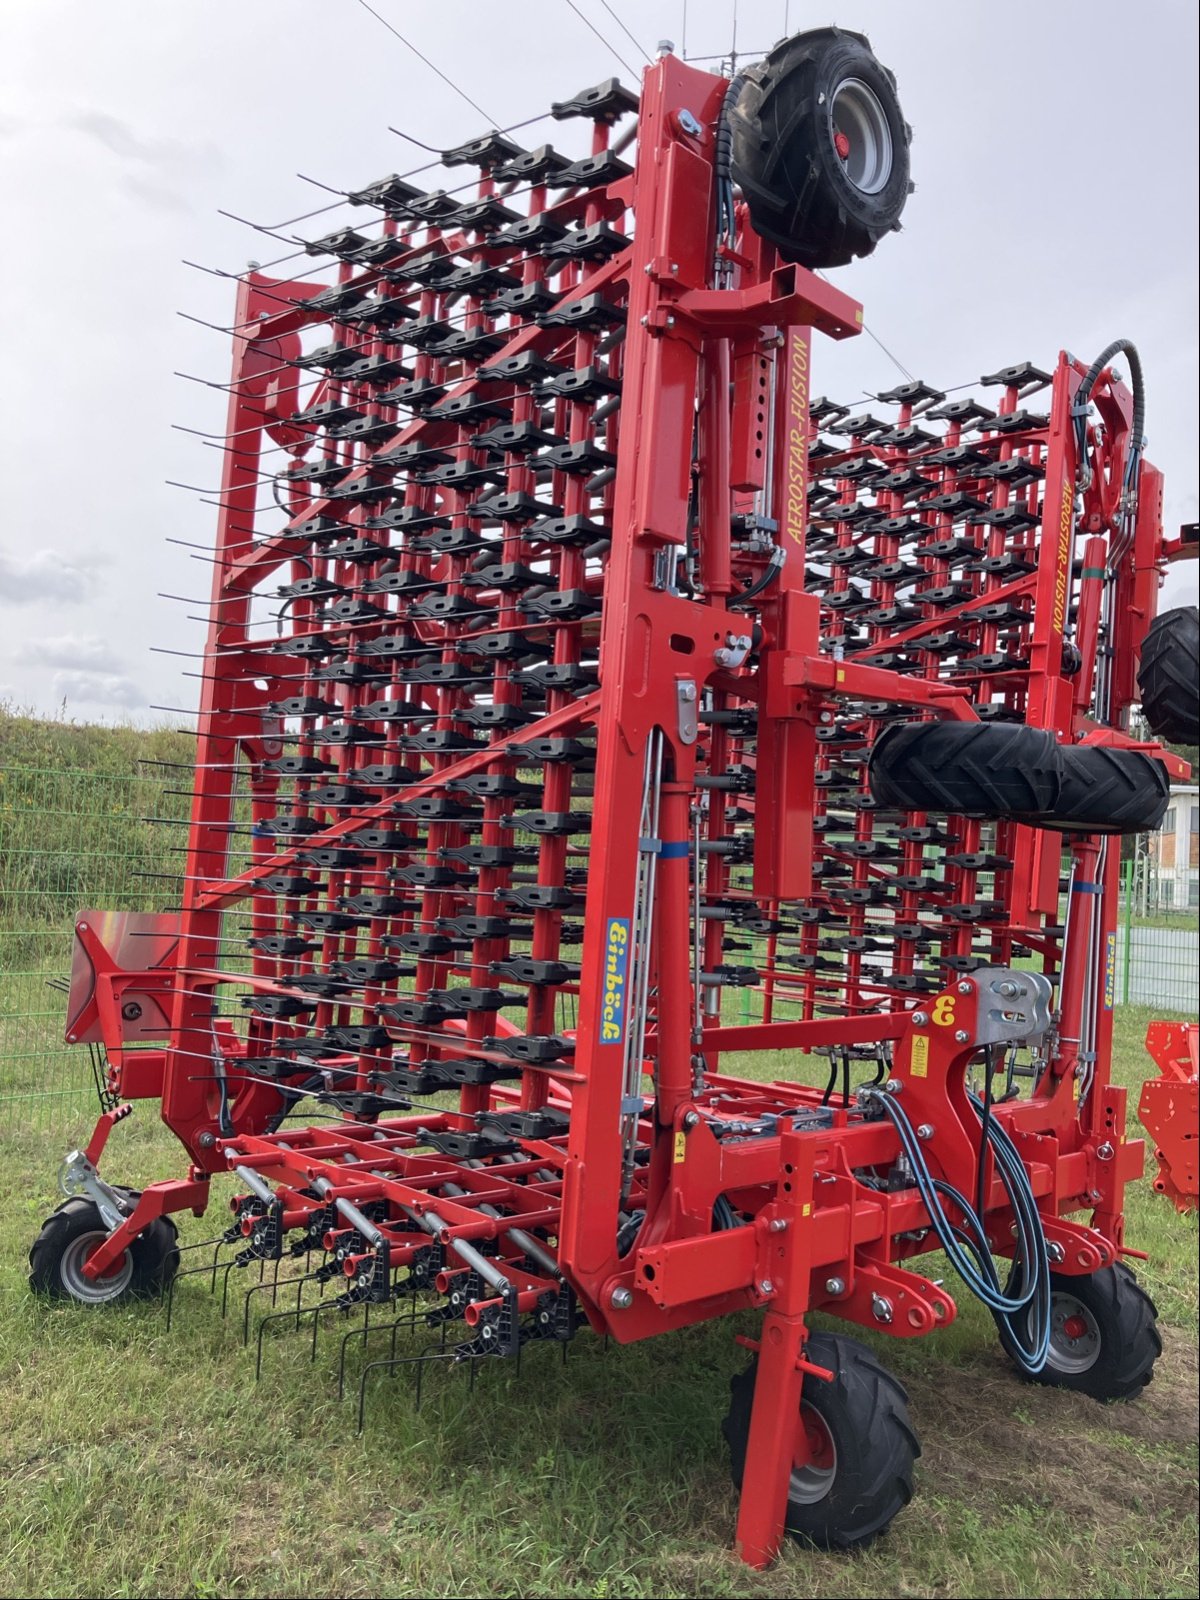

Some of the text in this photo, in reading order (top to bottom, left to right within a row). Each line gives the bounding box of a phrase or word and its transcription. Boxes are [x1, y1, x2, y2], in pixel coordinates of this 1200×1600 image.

[787, 334, 808, 545] AEROSTAR-FUSION
[1053, 479, 1073, 634] AEROSTAR-FUSION
[603, 922, 627, 1040] Einböck
